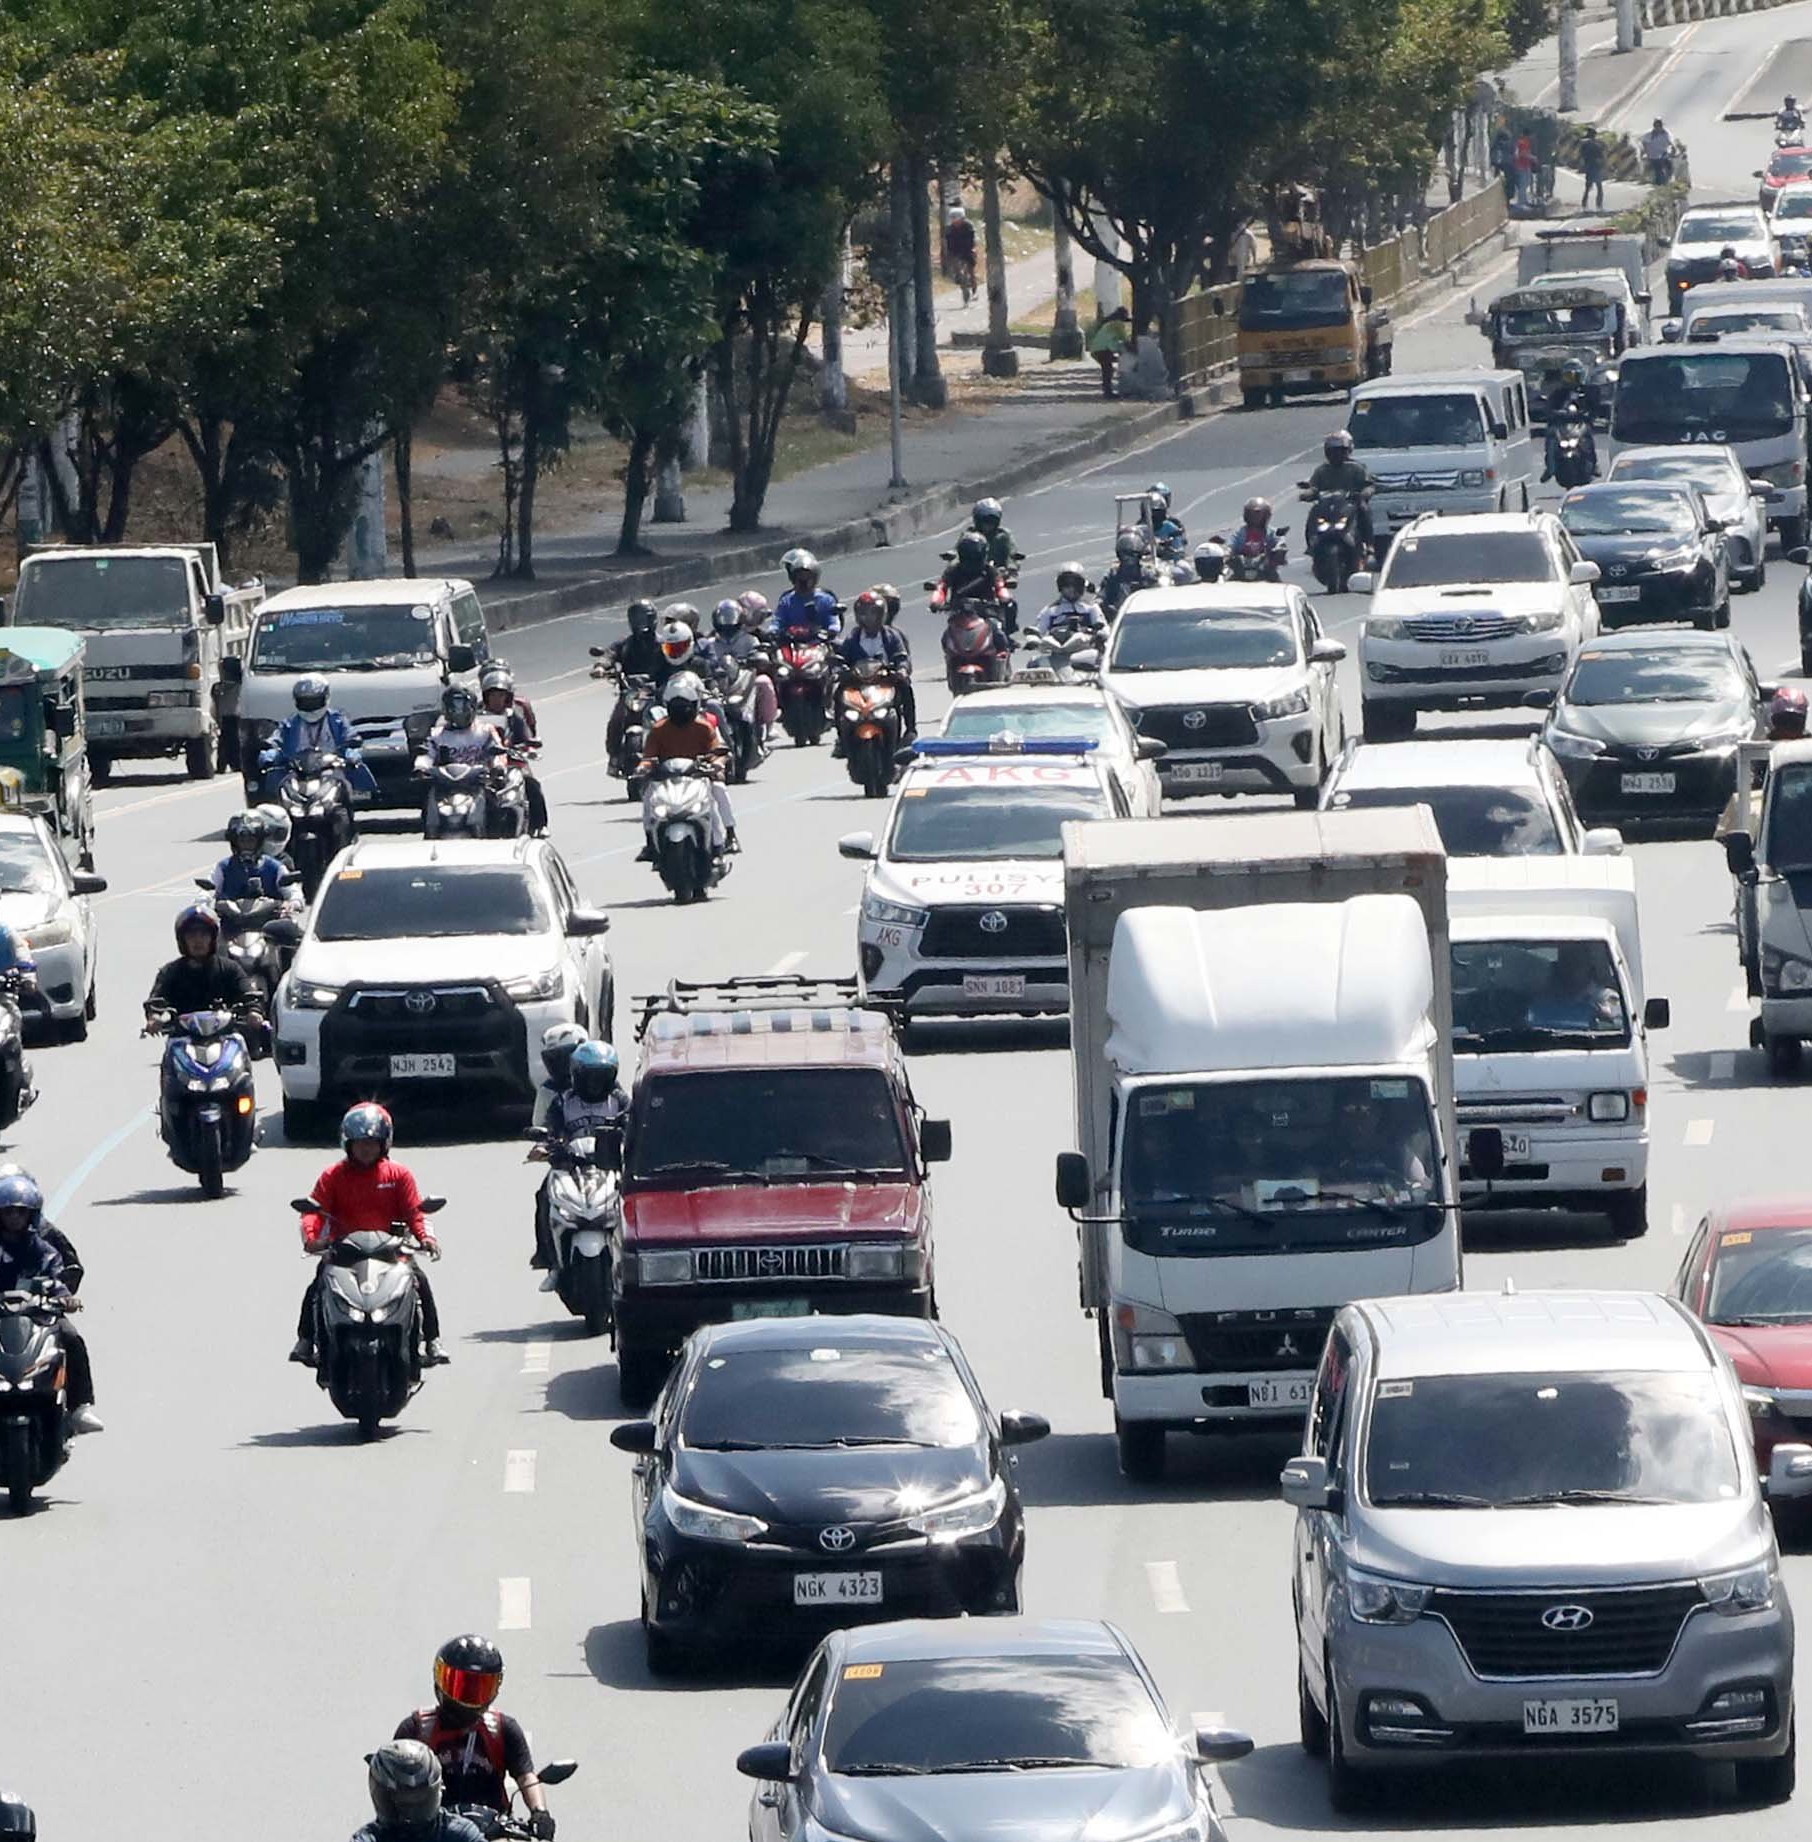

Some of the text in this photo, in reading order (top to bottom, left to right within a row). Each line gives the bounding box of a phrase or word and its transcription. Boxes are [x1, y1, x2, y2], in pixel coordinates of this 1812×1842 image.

[936, 766, 1070, 783] AKG
[911, 873, 1065, 888] PULISY
[964, 883, 1026, 897] 307
[876, 927, 901, 947] AKG
[423, 1058, 454, 1071] 2542
[1251, 1386, 1278, 1402] NBI
[796, 1577, 880, 1598] NGK 4323
[1526, 1705, 1616, 1726] NGA 3575
